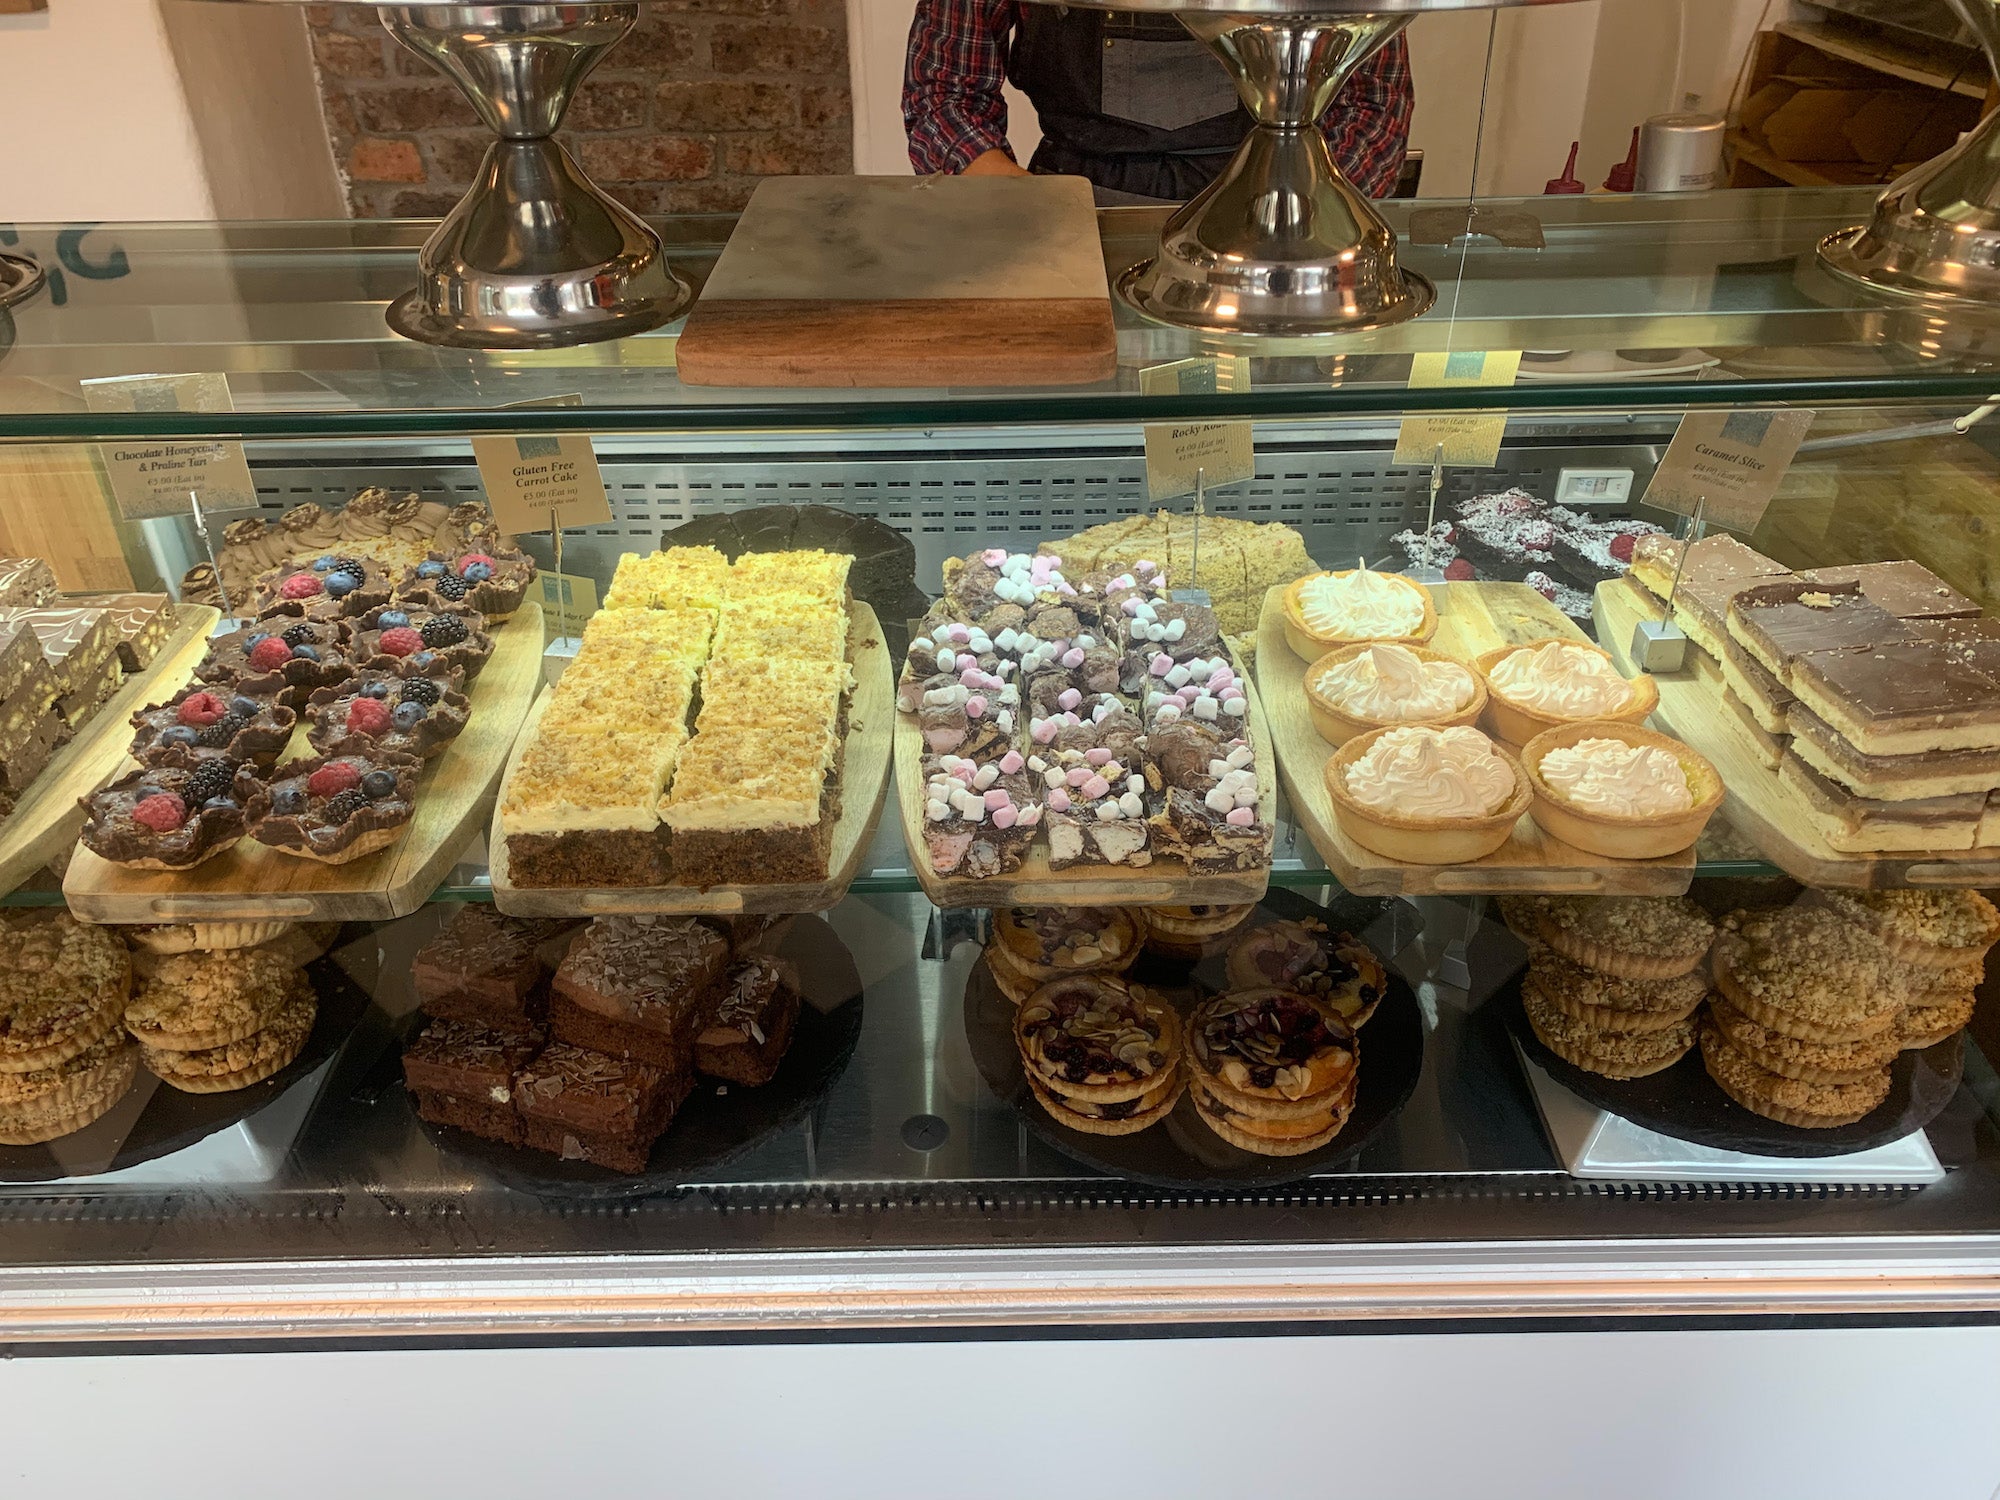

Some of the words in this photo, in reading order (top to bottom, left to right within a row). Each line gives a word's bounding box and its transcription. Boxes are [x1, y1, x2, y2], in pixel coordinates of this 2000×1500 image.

[1172, 425, 1201, 439] Rocky
[114, 448, 162, 461] Chocolate
[1695, 443, 1740, 463] Caramel
[1738, 455, 1766, 470] Slice
[138, 463, 148, 472] &
[151, 460, 186, 471] Praline
[187, 457, 207, 468] Tart
[513, 466, 547, 476] Gluten
[551, 462, 574, 471] Free
[516, 476, 549, 488] Carrot
[552, 472, 578, 483] Cake
[548, 488, 565, 498] (Eat
[567, 487, 578, 496] in)
